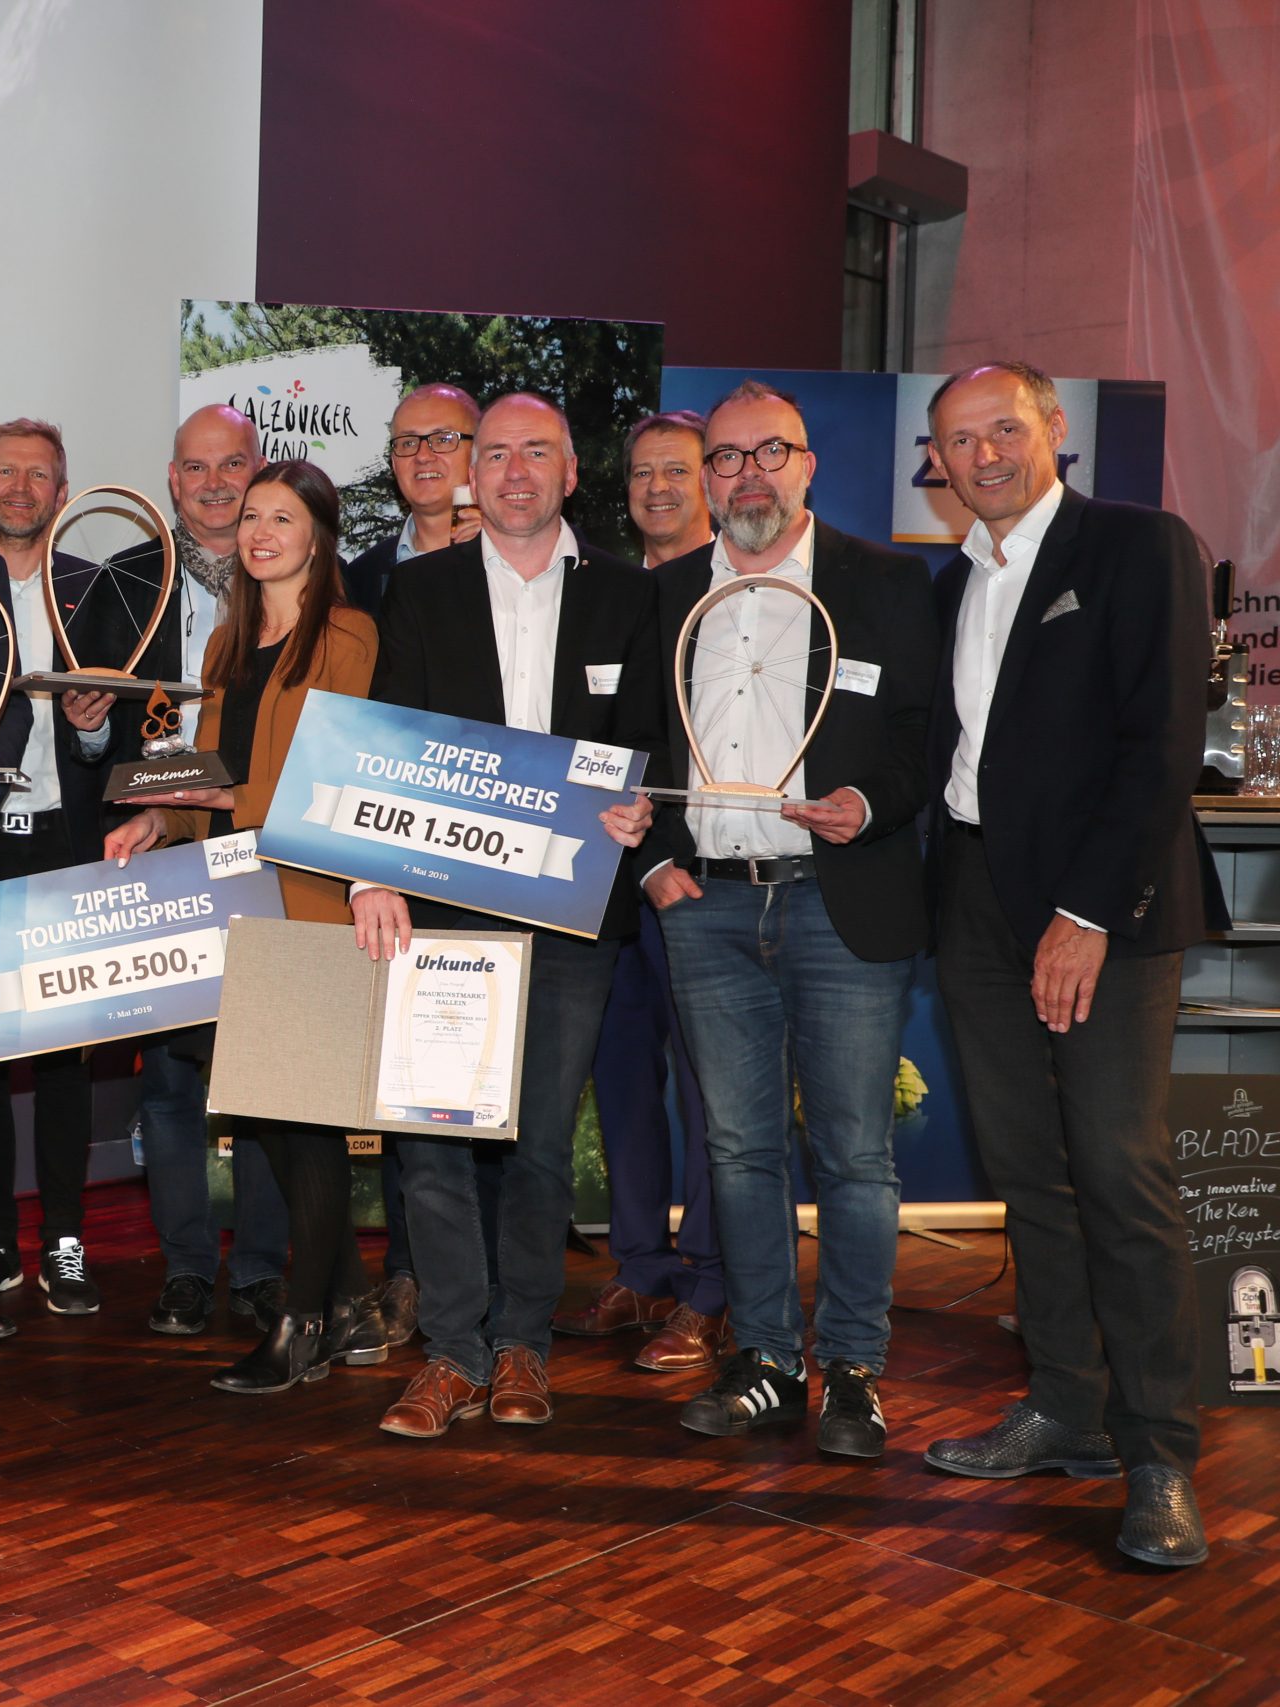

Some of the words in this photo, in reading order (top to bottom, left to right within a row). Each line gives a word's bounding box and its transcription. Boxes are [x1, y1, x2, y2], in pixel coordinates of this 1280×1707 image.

[420, 740, 502, 777] ZIPFER
[575, 755, 624, 777] Zipfer
[129, 766, 204, 787] Stoneman
[355, 751, 560, 814] TOURISMUSPREIS
[353, 800, 416, 838] EUR
[423, 817, 524, 865] 1.500,-
[210, 847, 254, 868] Zipfer
[402, 864, 411, 872] 7.
[412, 866, 427, 877] Mai
[428, 869, 450, 881] 2019
[72, 881, 150, 916] ZIPFER
[16, 893, 214, 950] TOURISMUSPREIS
[38, 964, 98, 999] EUR
[105, 947, 207, 987] 2.500,-
[415, 954, 496, 973] Urkunde
[417, 990, 487, 1000] BRAUKUNSTMARKT
[107, 1012, 116, 1020] 7.
[117, 1009, 132, 1019] Mai
[132, 1005, 153, 1016] 2019
[1175, 1127, 1280, 1160] BLADE
[1178, 1185, 1201, 1199] Das
[1187, 1200, 1222, 1223] The
[1226, 1202, 1259, 1221] Ken
